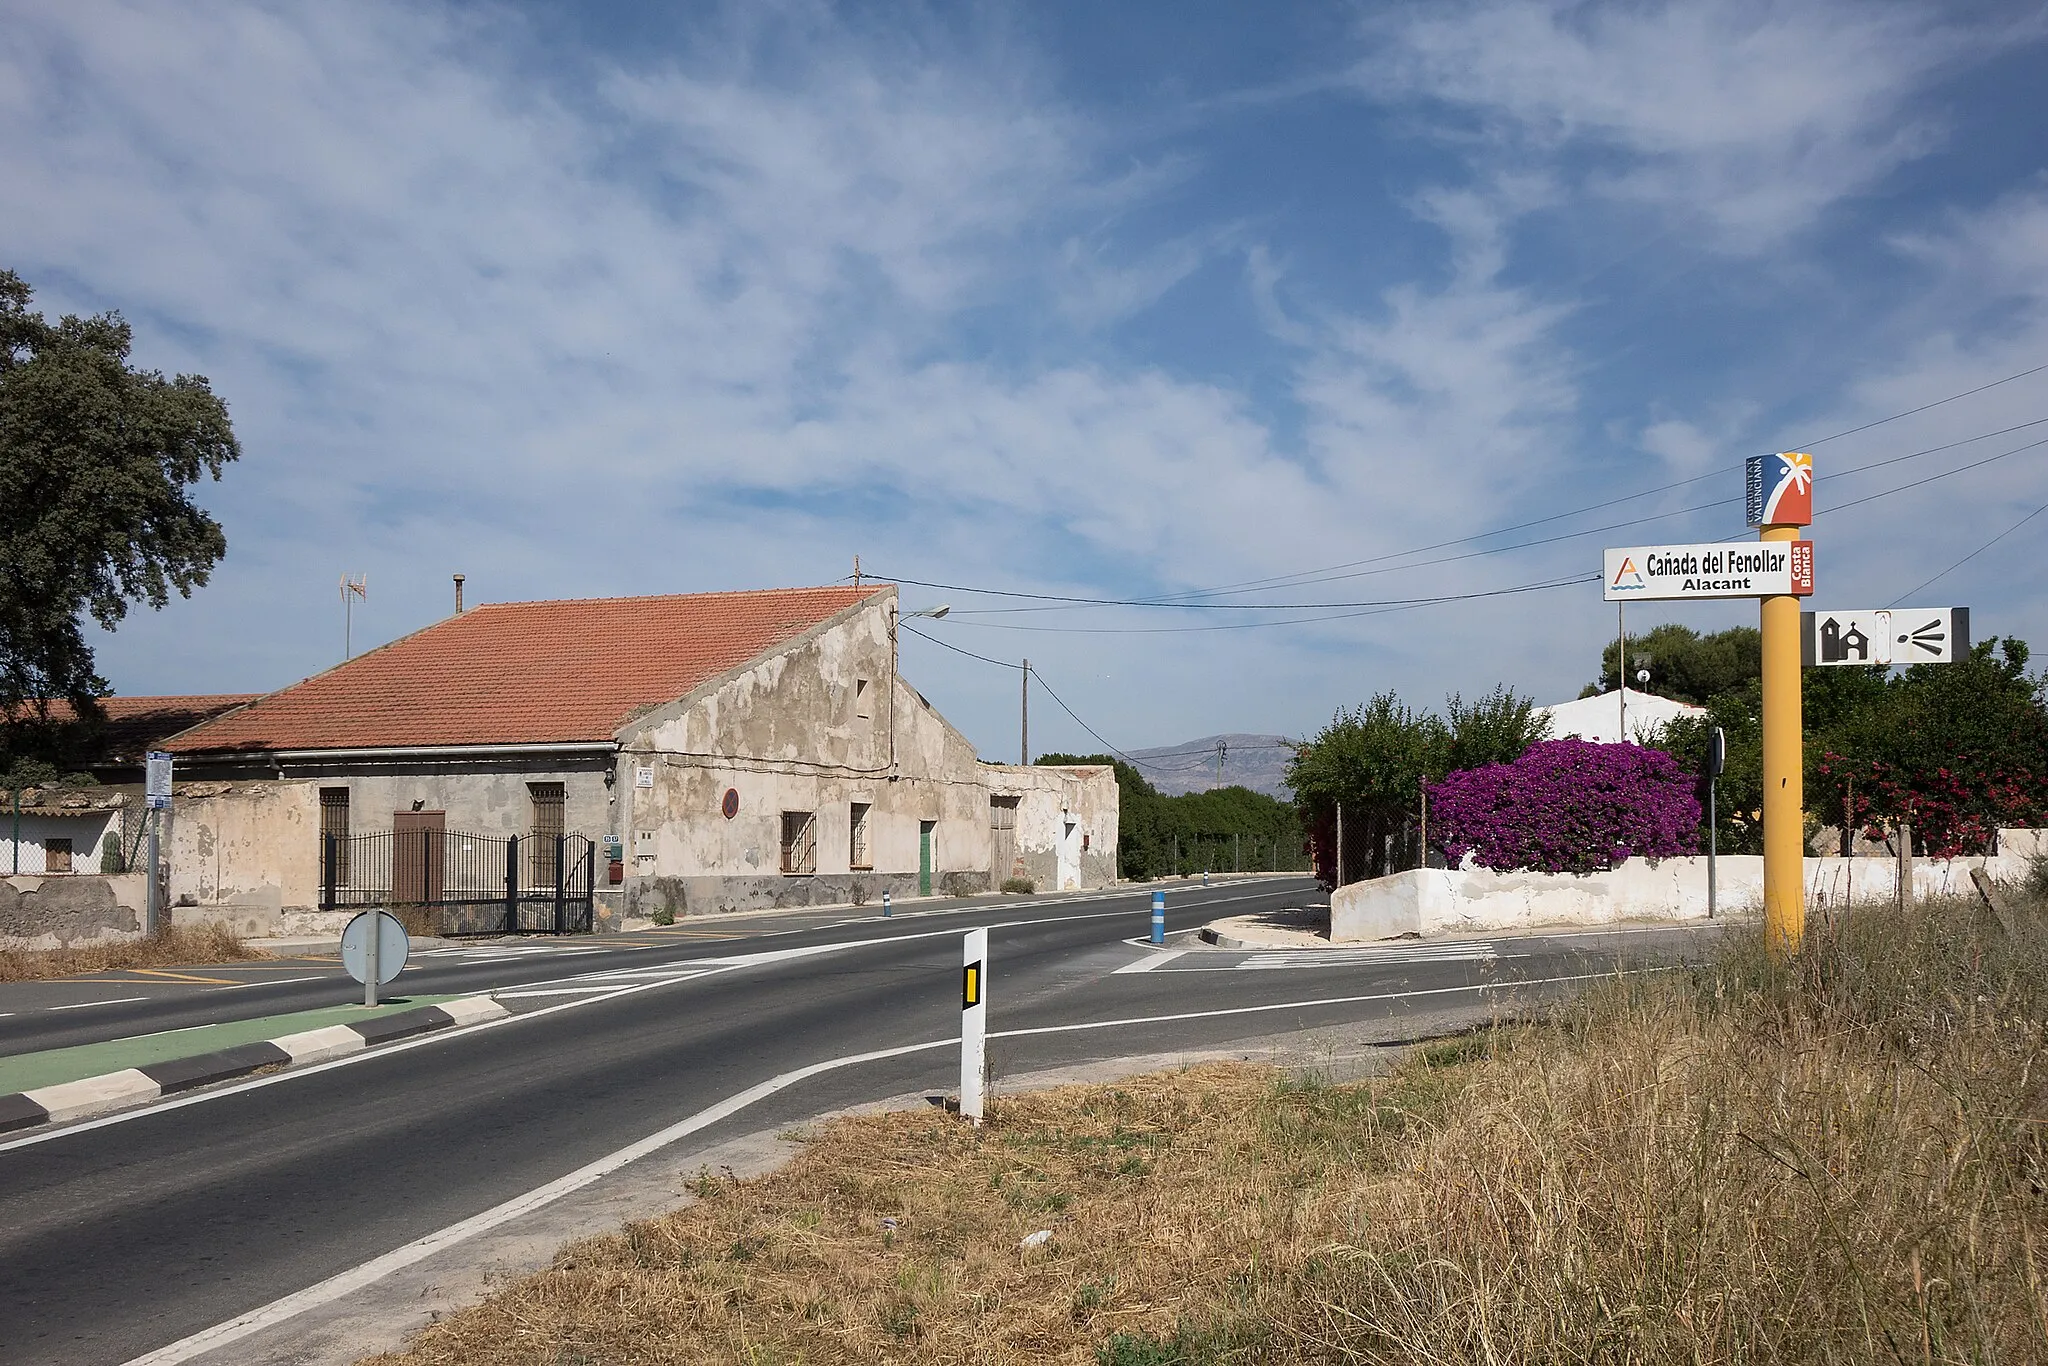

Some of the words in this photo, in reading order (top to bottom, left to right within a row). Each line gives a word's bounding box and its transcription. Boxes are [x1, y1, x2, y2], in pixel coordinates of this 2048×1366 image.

[1754, 458, 1762, 522] VALENCIANA
[1647, 552, 1697, 577] Cañada
[1702, 551, 1723, 574] del
[1728, 549, 1785, 573] Fenollar
[1791, 546, 1802, 581] Costa
[1801, 546, 1811, 588] Blanca
[1681, 577, 1751, 591] Alacant
